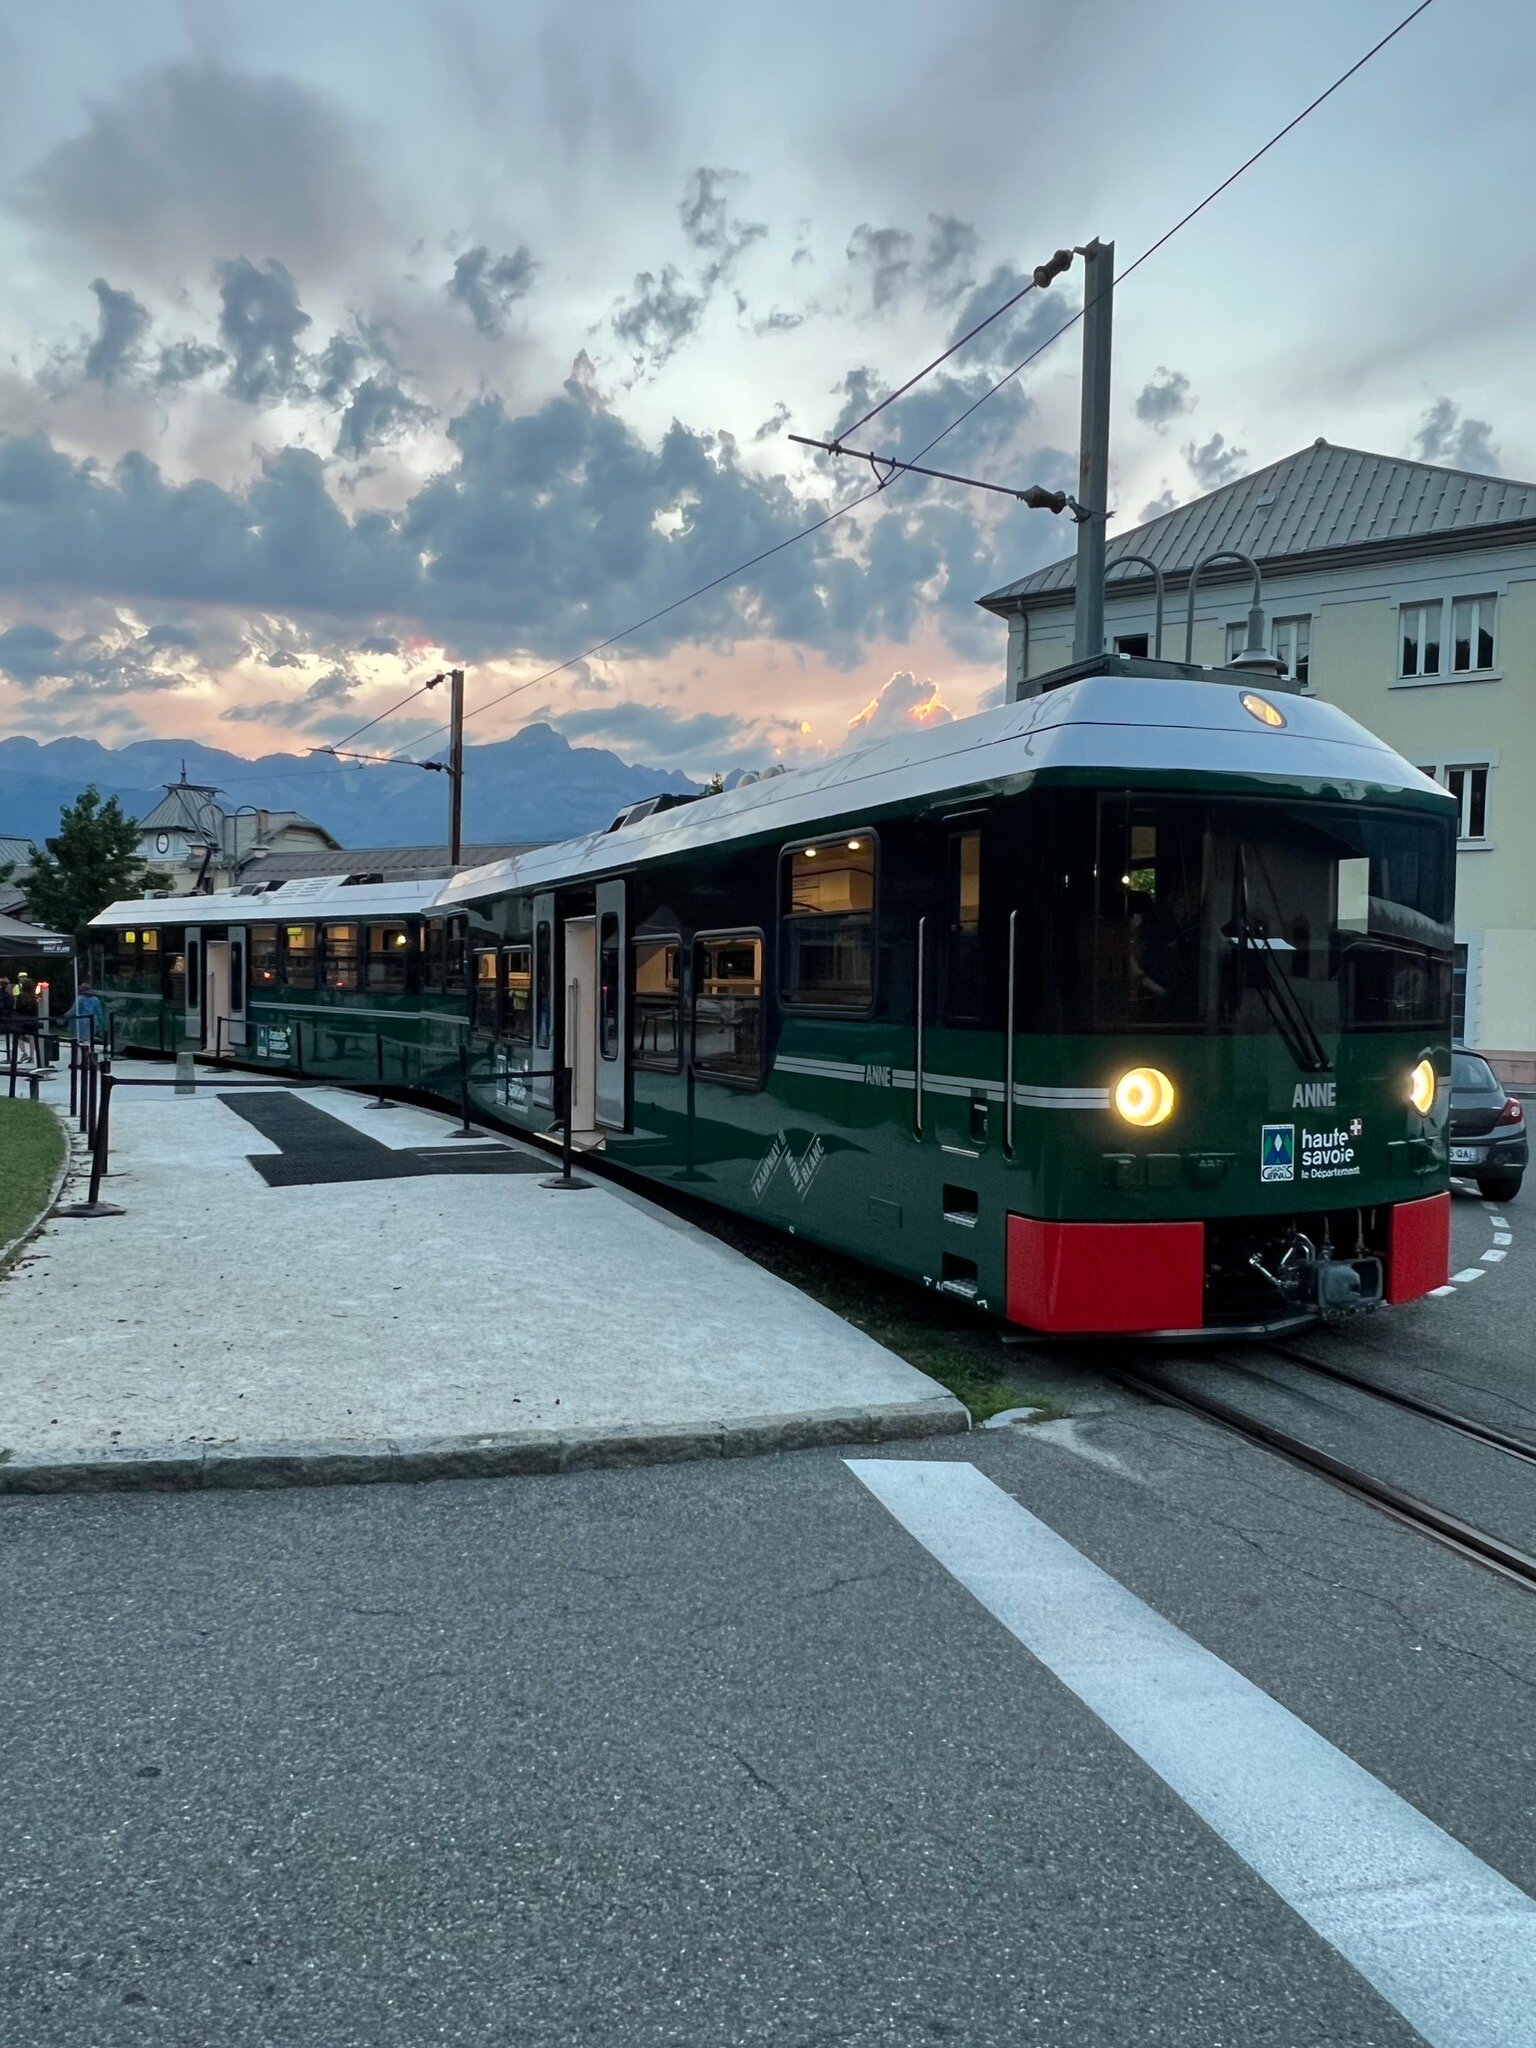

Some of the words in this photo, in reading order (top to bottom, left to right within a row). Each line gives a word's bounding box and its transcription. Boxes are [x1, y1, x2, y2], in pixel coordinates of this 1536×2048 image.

[865, 1064, 891, 1087] ANNE
[1292, 1082, 1336, 1108] ANNE
[1302, 1127, 1349, 1149] haute
[752, 1139, 780, 1198] TRAMWAY
[801, 1137, 825, 1183] BLANC
[1302, 1148, 1355, 1166] savoie
[784, 1150, 804, 1192] MONT
[1301, 1169, 1309, 1179] le
